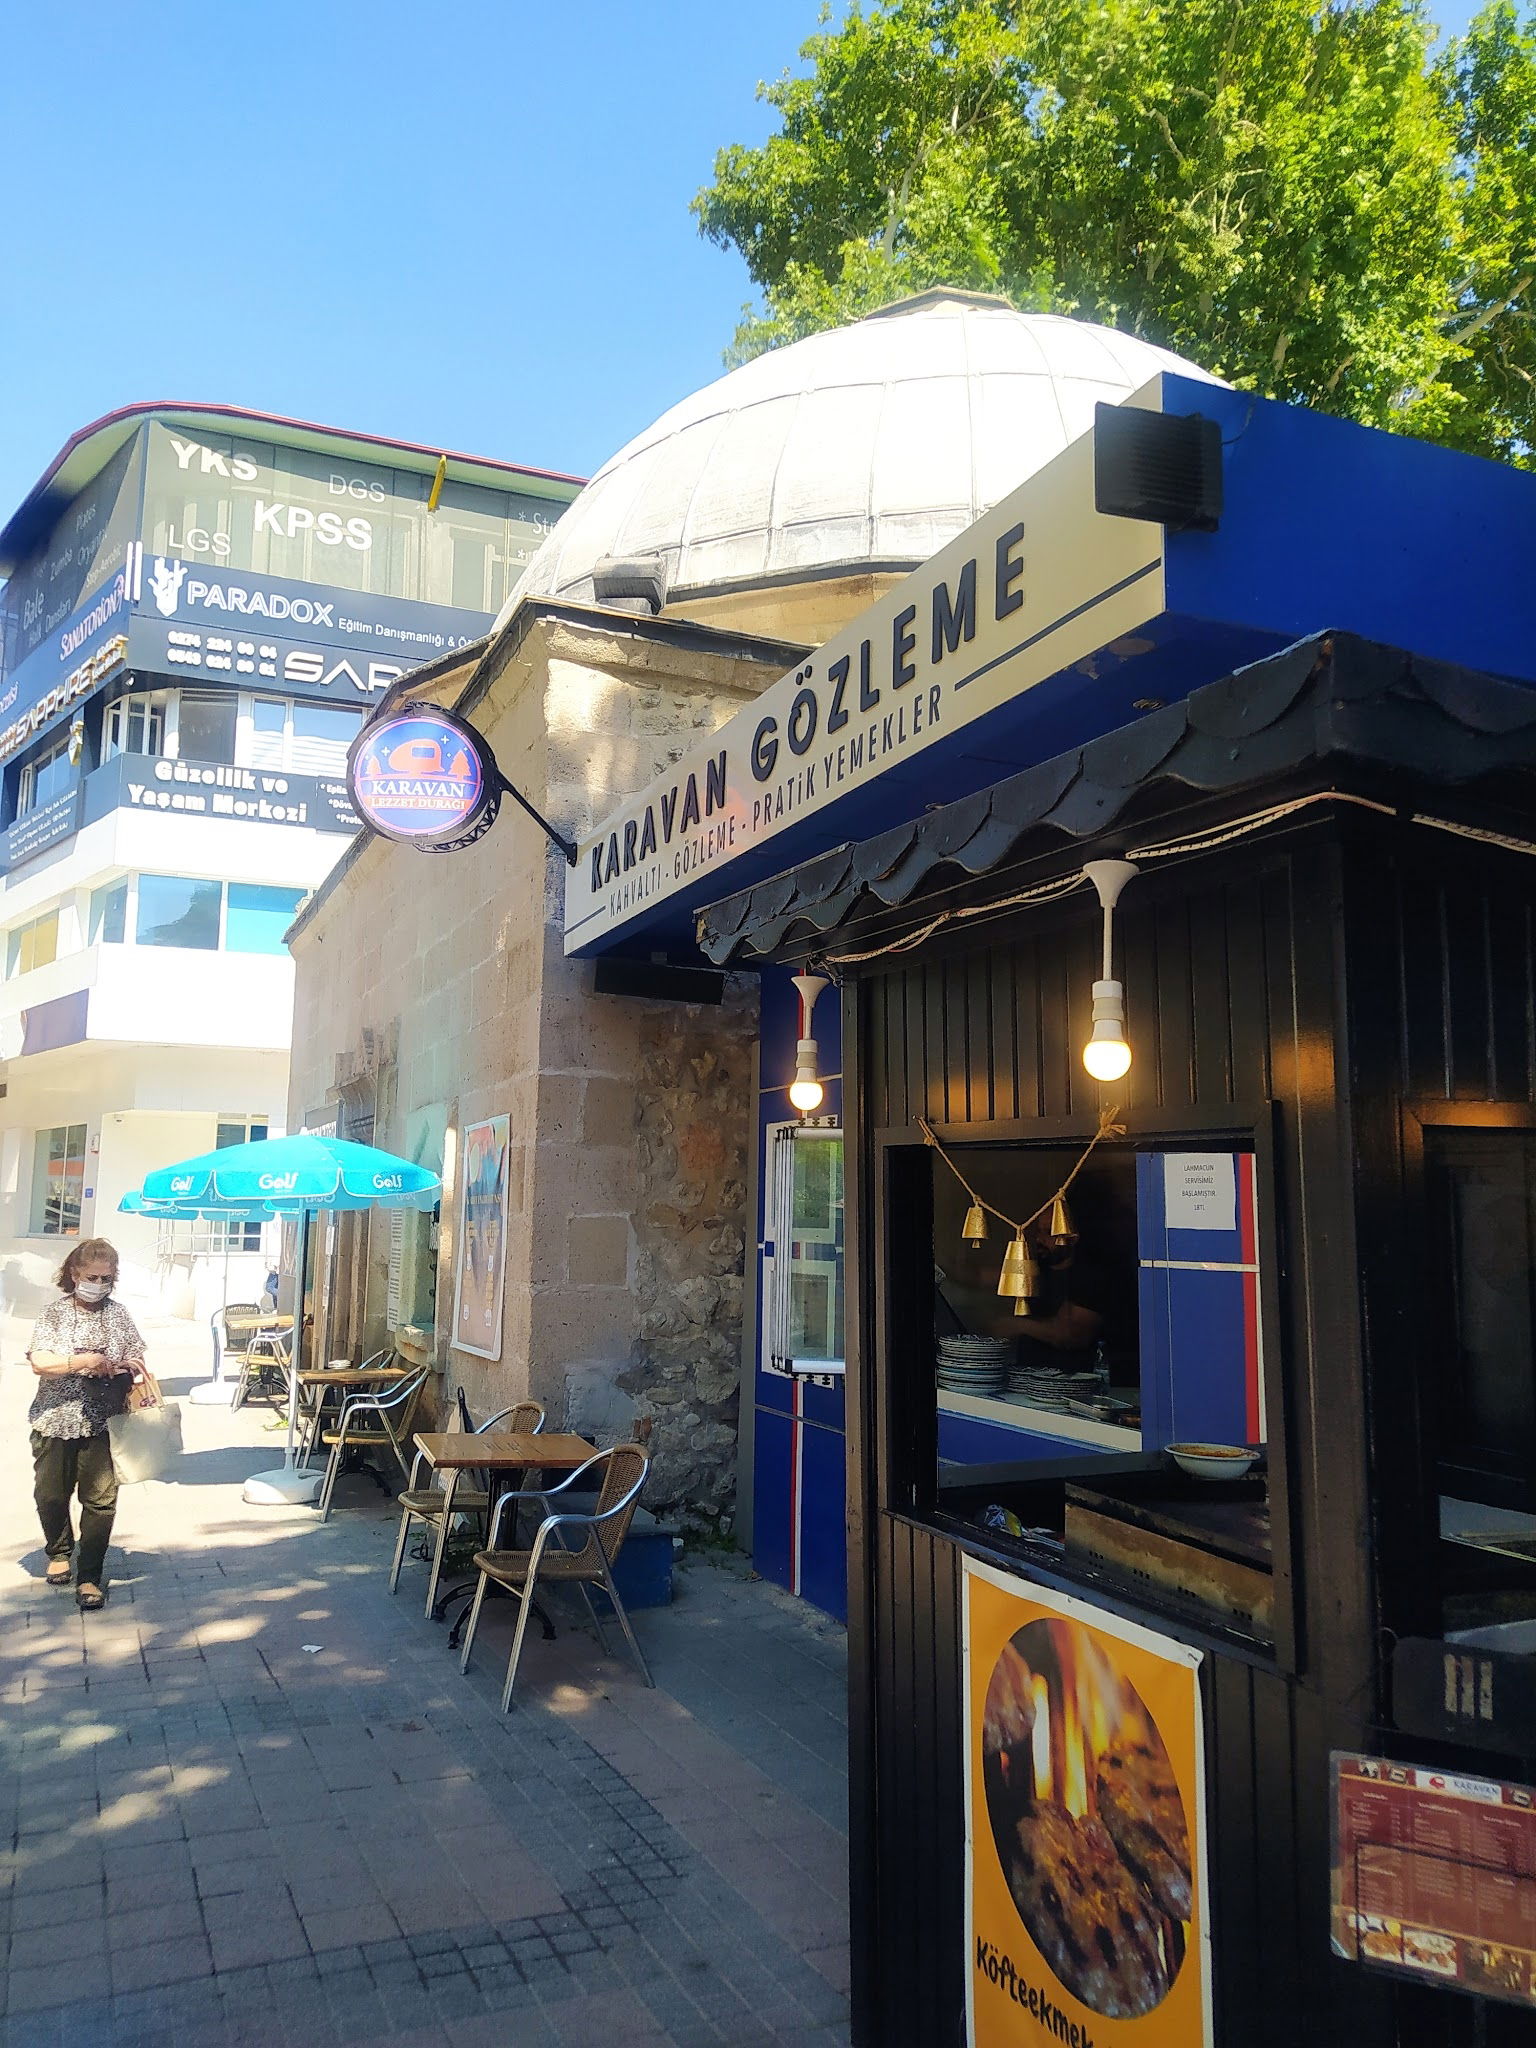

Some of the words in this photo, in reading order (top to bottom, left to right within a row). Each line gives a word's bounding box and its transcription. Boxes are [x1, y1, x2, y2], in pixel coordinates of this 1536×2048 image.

[170, 440, 258, 481] YKS
[329, 474, 385, 503] DGS
[168, 524, 231, 556] LGS
[254, 499, 373, 551] KPSS
[187, 580, 334, 628] PARADOX
[338, 618, 372, 634] Eğitim
[375, 624, 444, 647] Danışmanlığı
[448, 637, 455, 647] &
[284, 650, 412, 692] SAP
[591, 750, 727, 893] KARAVAN
[751, 522, 1025, 782] GÖZLEME
[155, 761, 256, 792] Güzellik
[261, 776, 289, 794] ve
[372, 781, 465, 797] KARAVAN
[128, 783, 206, 811] Yaşam
[212, 793, 307, 823] Merkezi
[372, 798, 414, 808] LEZZET
[610, 863, 661, 918] KAHVALTI
[674, 815, 735, 880] GÖZLEME
[824, 684, 941, 789] YEMEKLER
[171, 1175, 194, 1191] Golf
[259, 1172, 298, 1190] Golf
[373, 1174, 403, 1189] Golf
[1183, 1164, 1214, 1172] LAHMACUN
